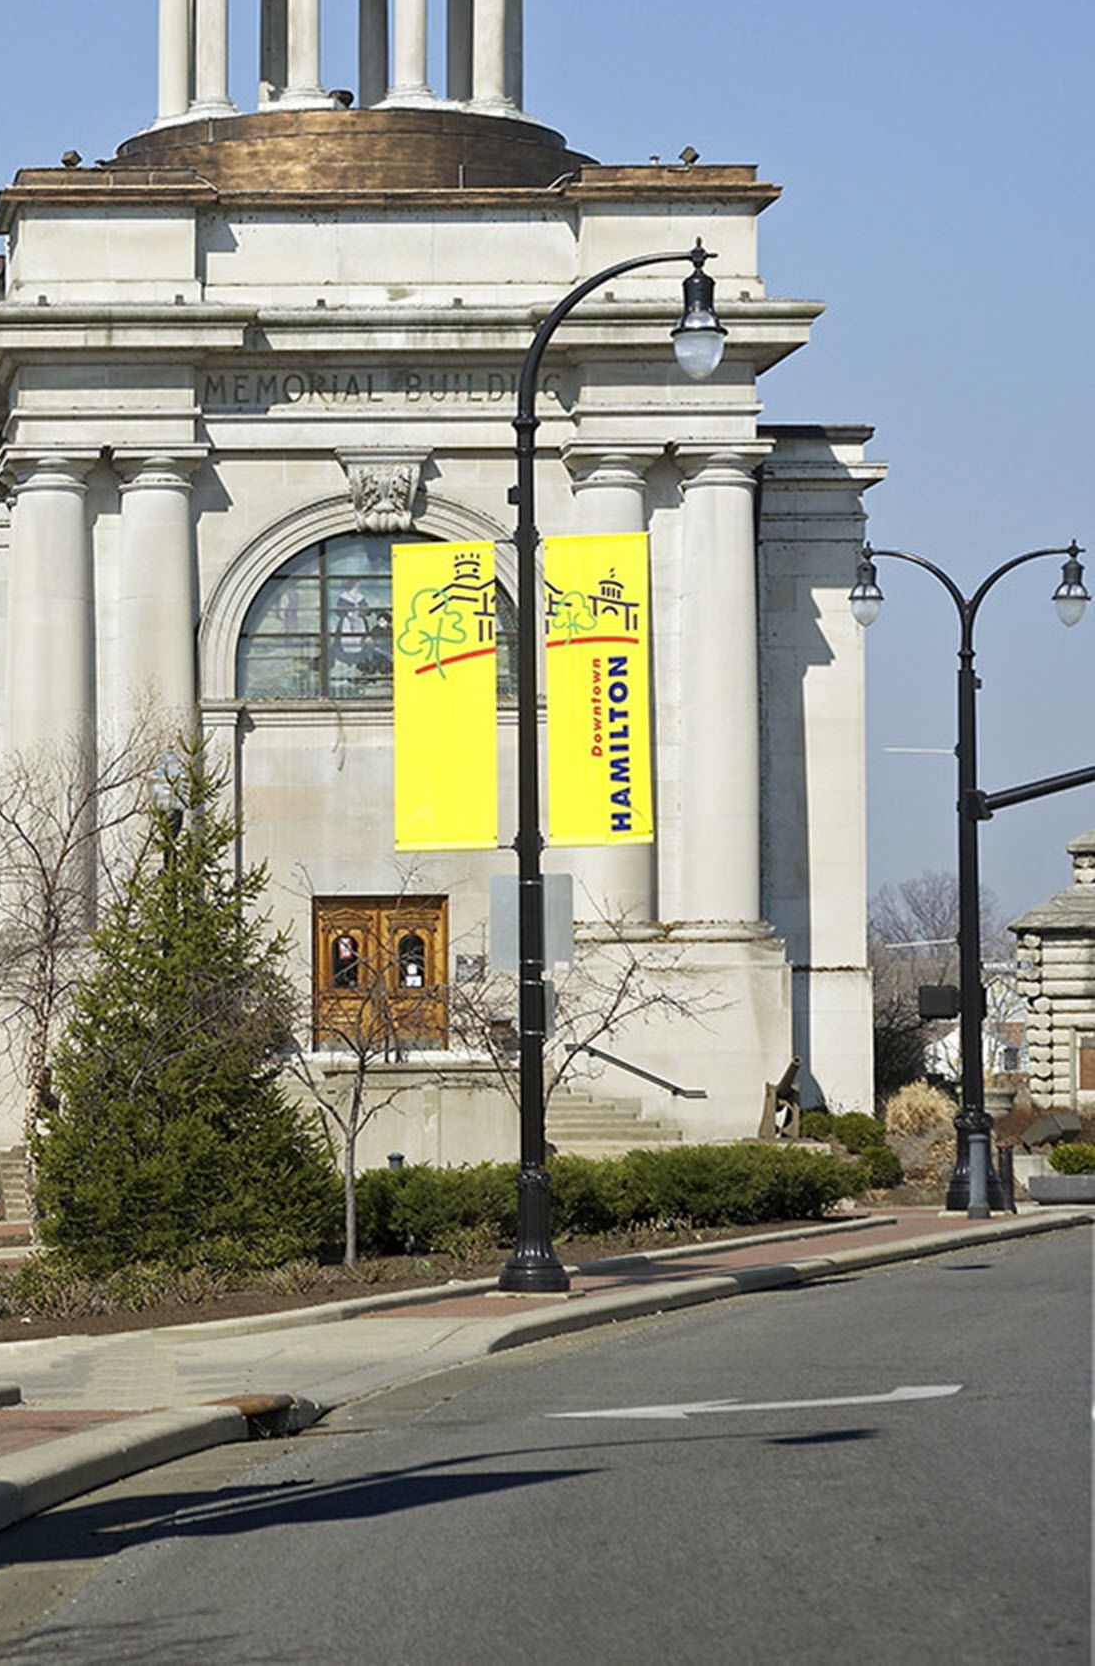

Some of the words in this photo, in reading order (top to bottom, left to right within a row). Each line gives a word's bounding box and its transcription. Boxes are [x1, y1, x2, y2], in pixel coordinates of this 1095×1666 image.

[205, 373, 383, 404] MEMORIAL
[405, 373, 561, 403] BUILDIG
[590, 657, 604, 757] Downtown
[607, 655, 632, 832] HAMILTON
